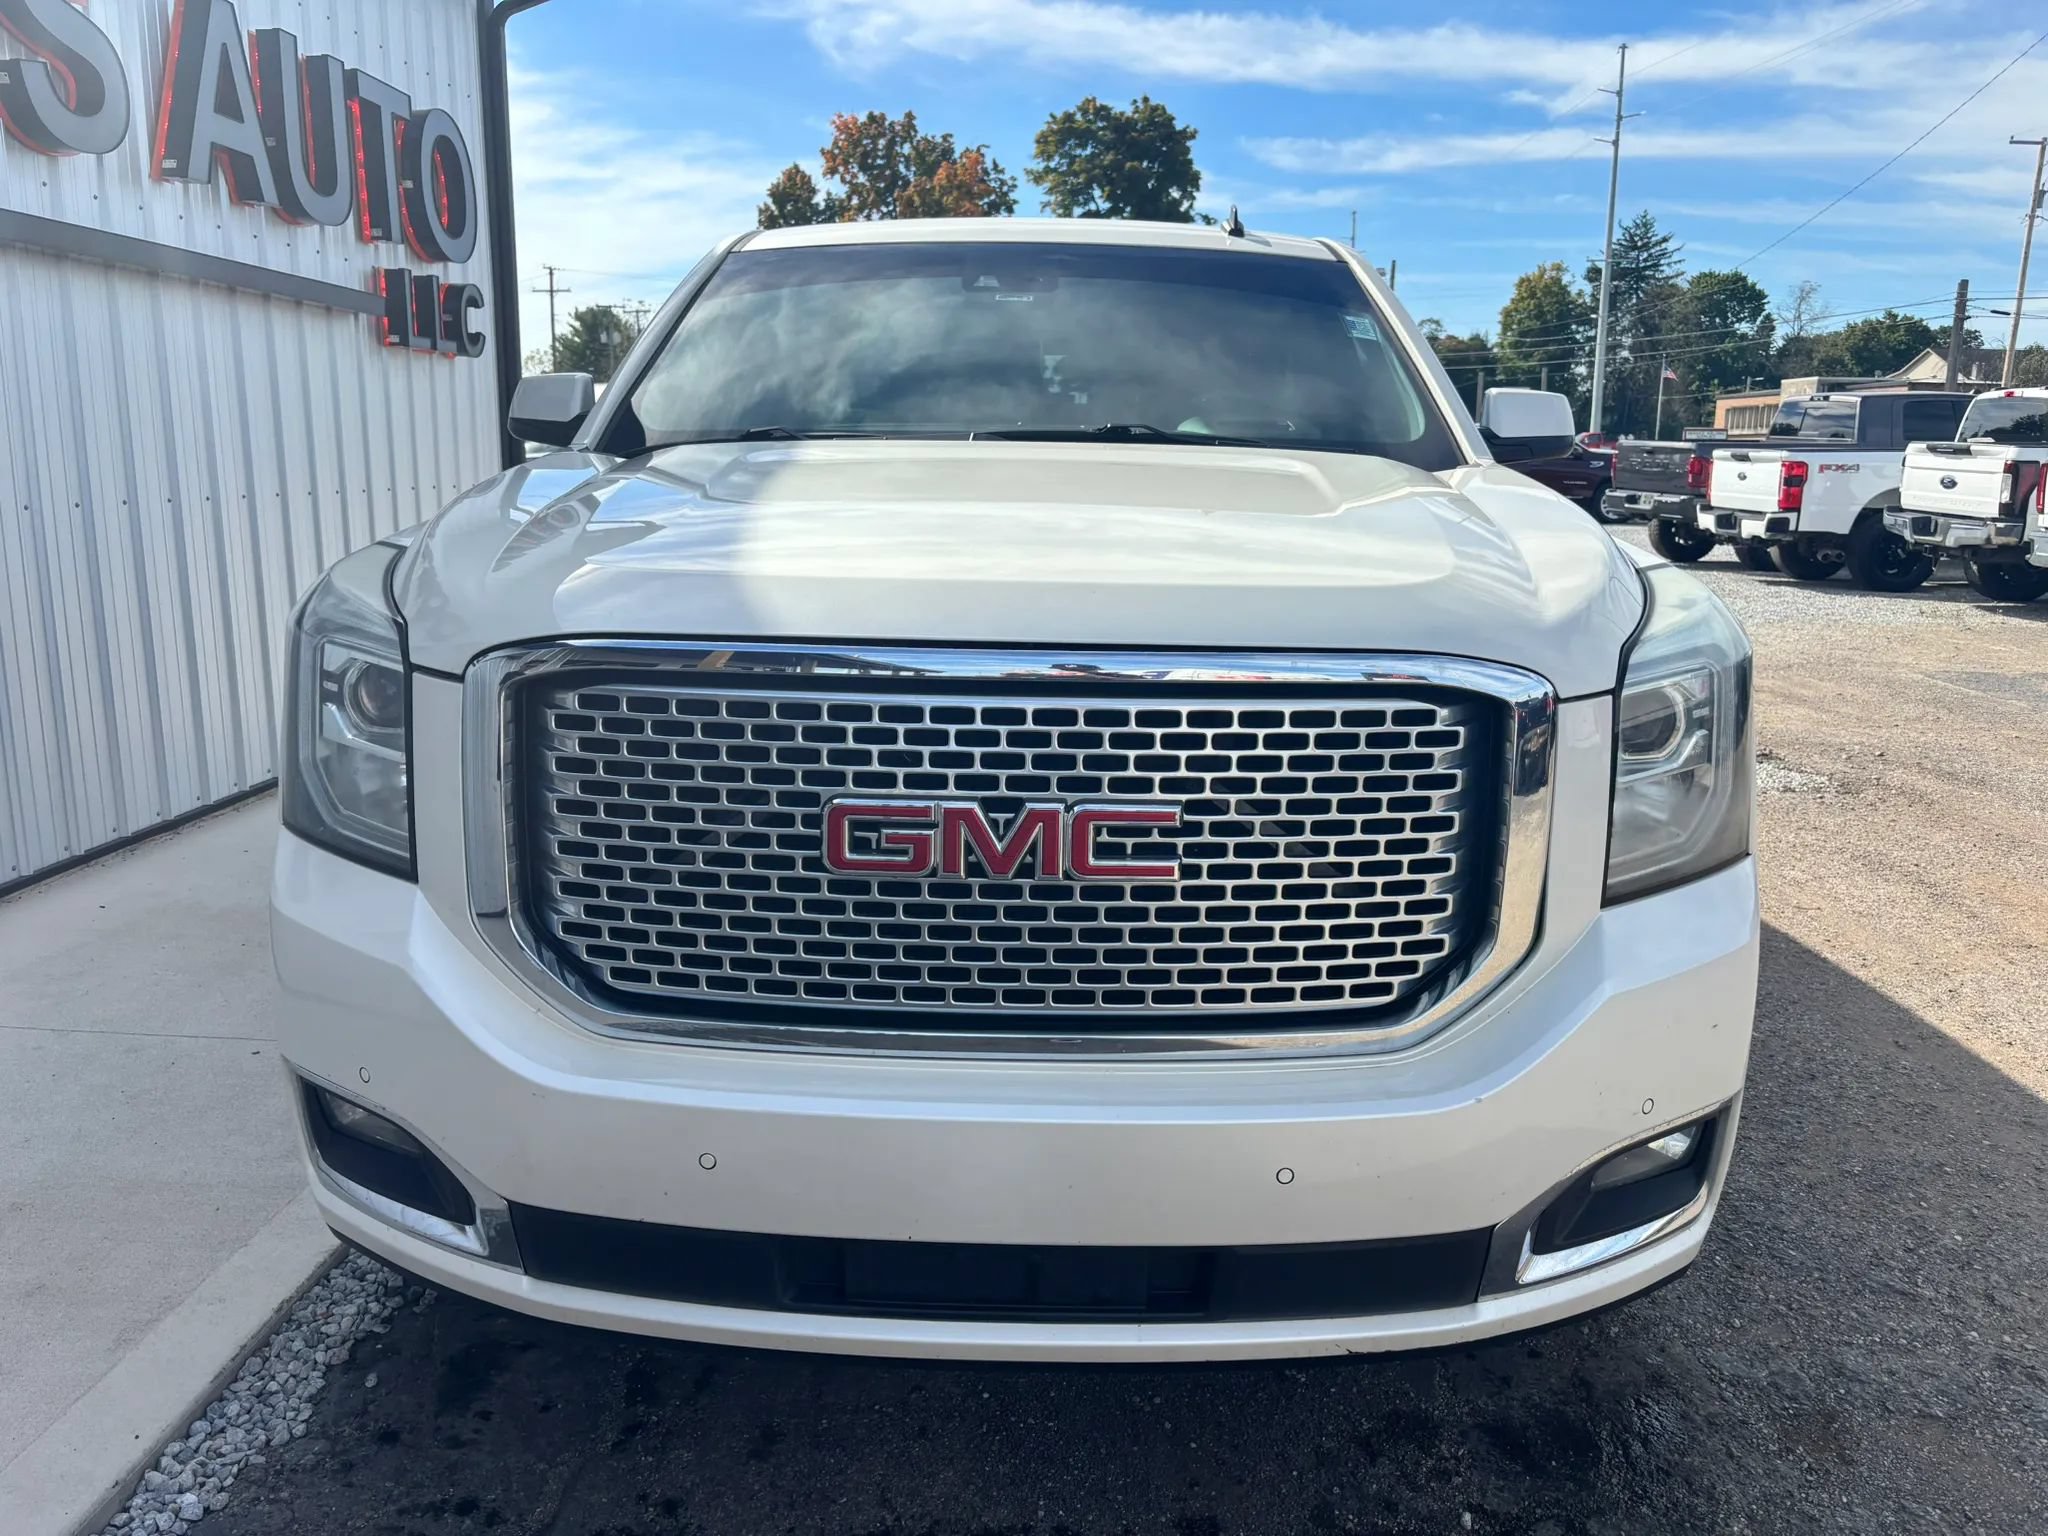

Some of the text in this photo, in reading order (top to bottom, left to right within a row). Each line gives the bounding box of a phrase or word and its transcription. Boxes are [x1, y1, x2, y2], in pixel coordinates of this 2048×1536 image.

[160, 0, 478, 263] AUTO
[384, 268, 486, 358] LLC
[1817, 463, 1860, 474] FX4
[822, 798, 1183, 882] GMC
